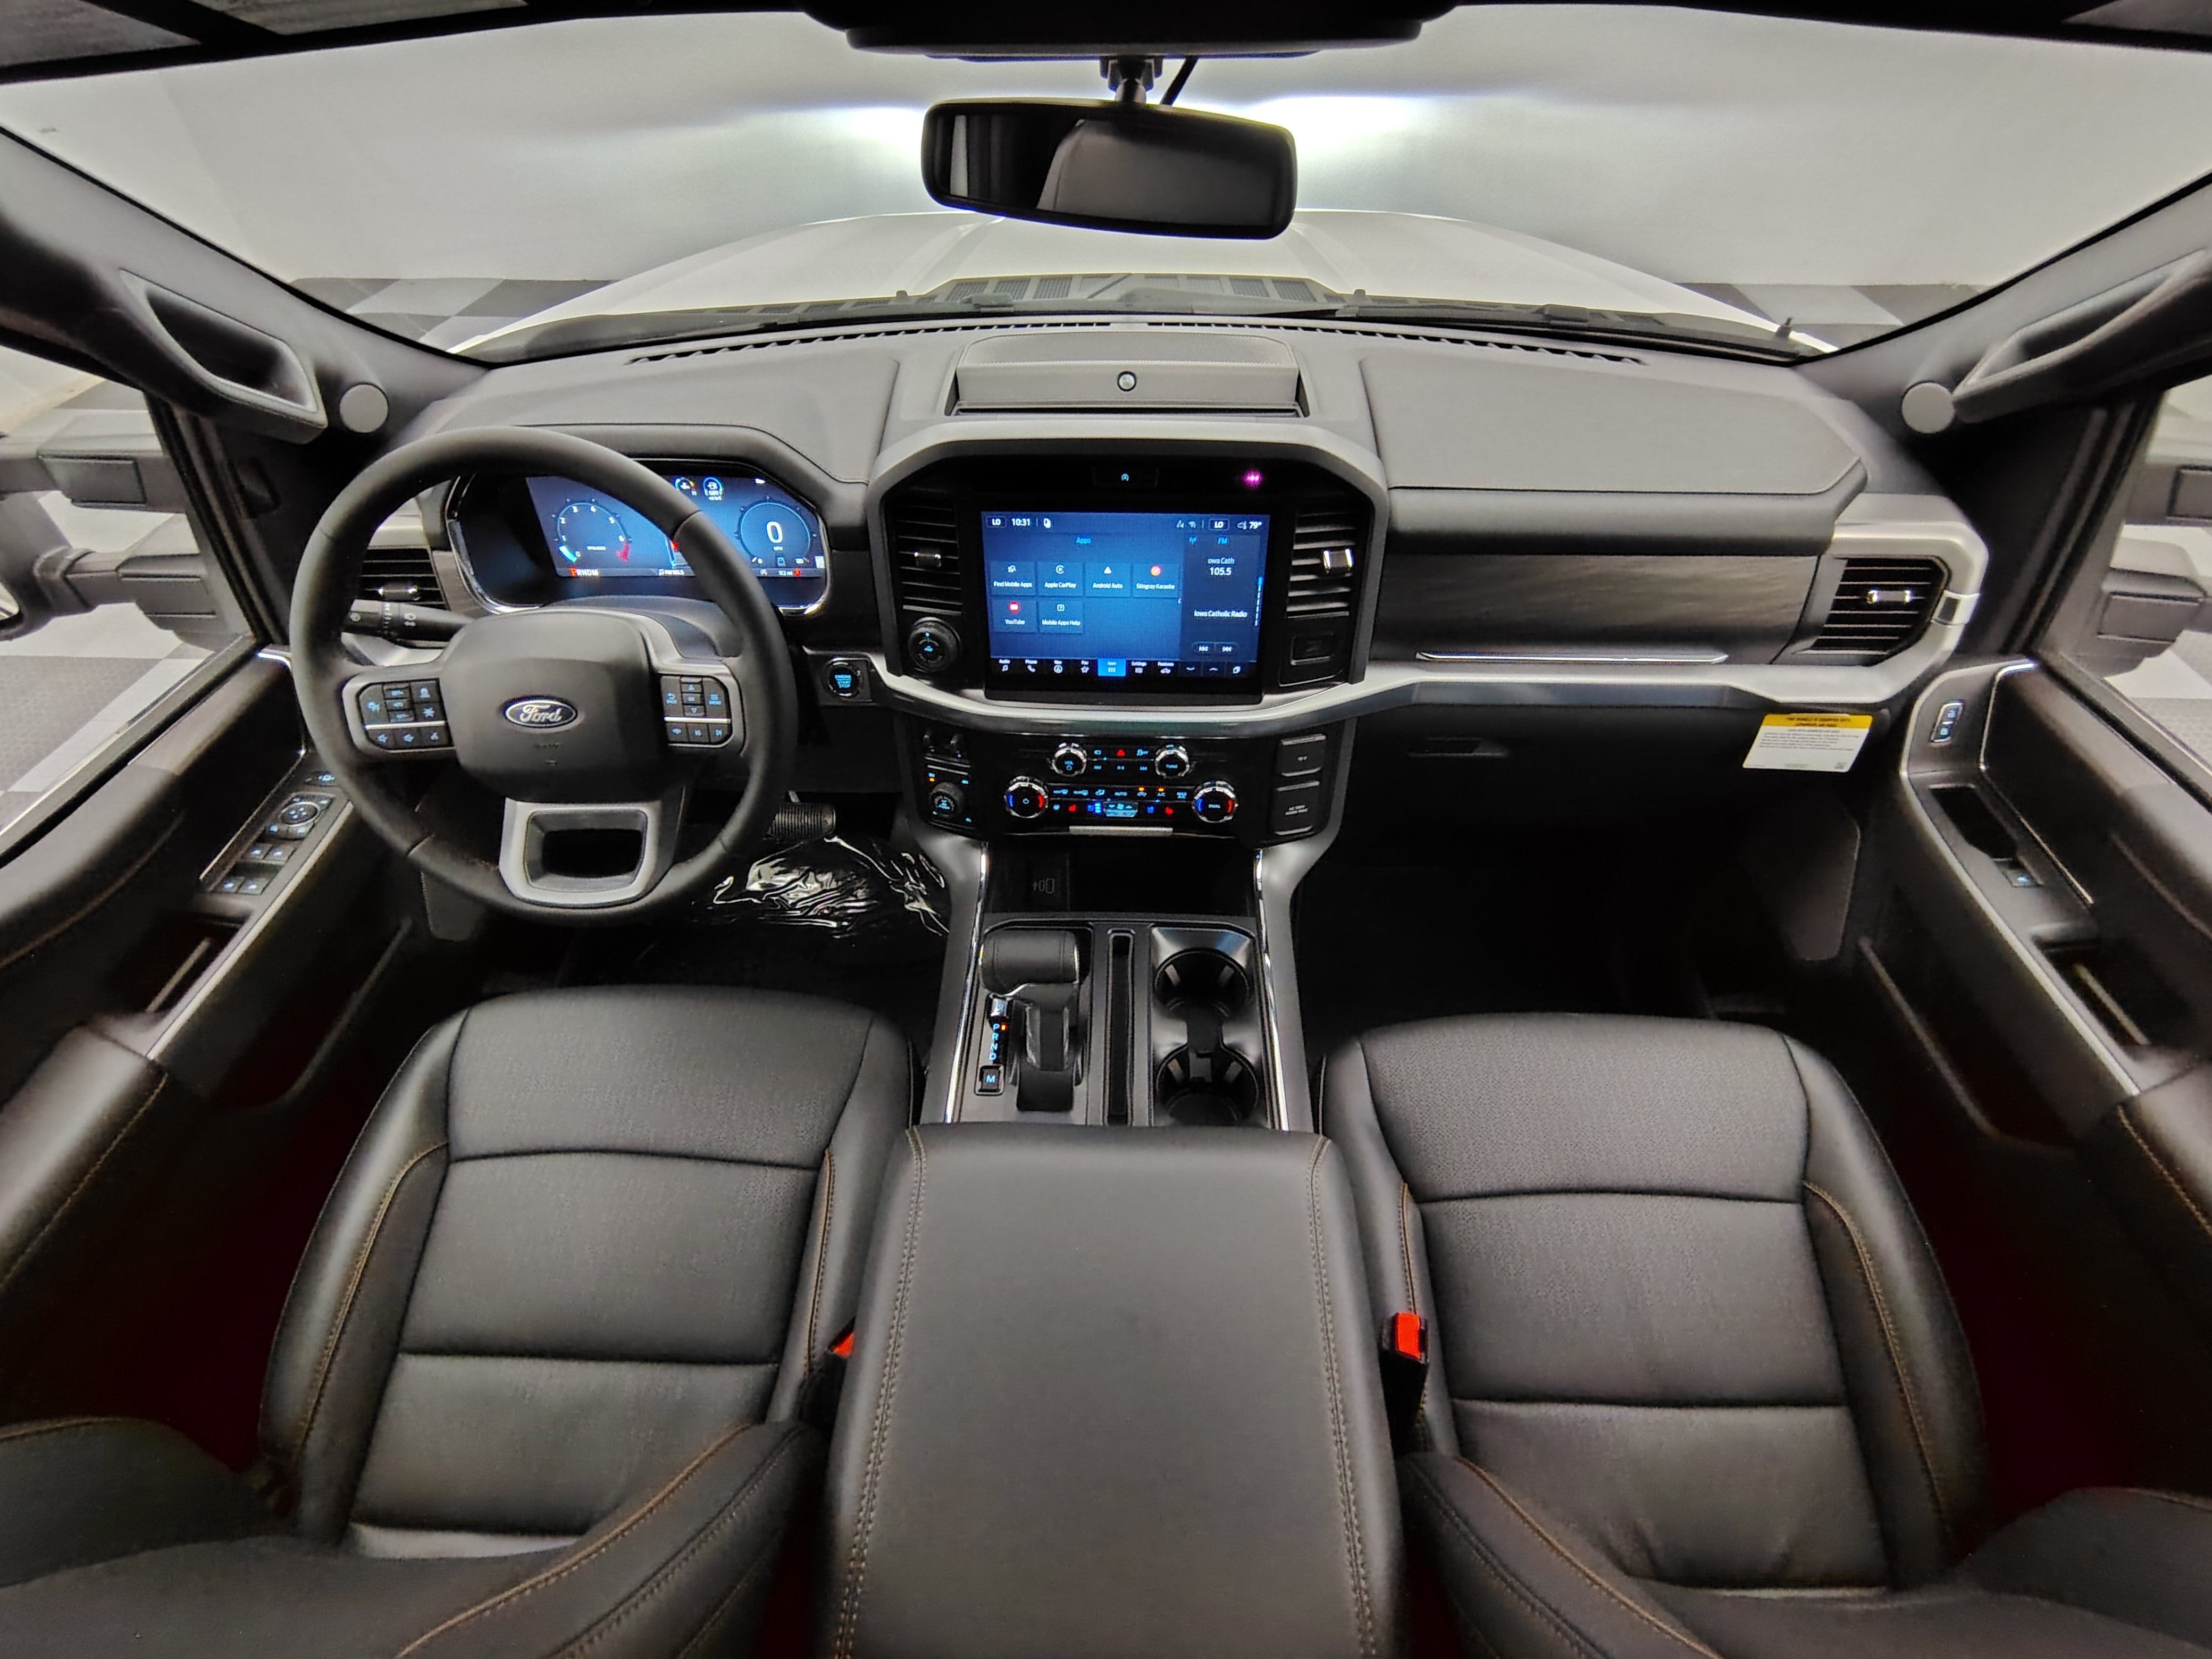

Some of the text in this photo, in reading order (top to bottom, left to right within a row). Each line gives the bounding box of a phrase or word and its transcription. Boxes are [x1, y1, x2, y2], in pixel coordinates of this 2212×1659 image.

[1011, 518, 1030, 526] 10:31
[766, 521, 783, 543] 0
[1210, 567, 1232, 576] 105.5
[520, 704, 562, 722] Ford
[986, 1075, 996, 1083] M
